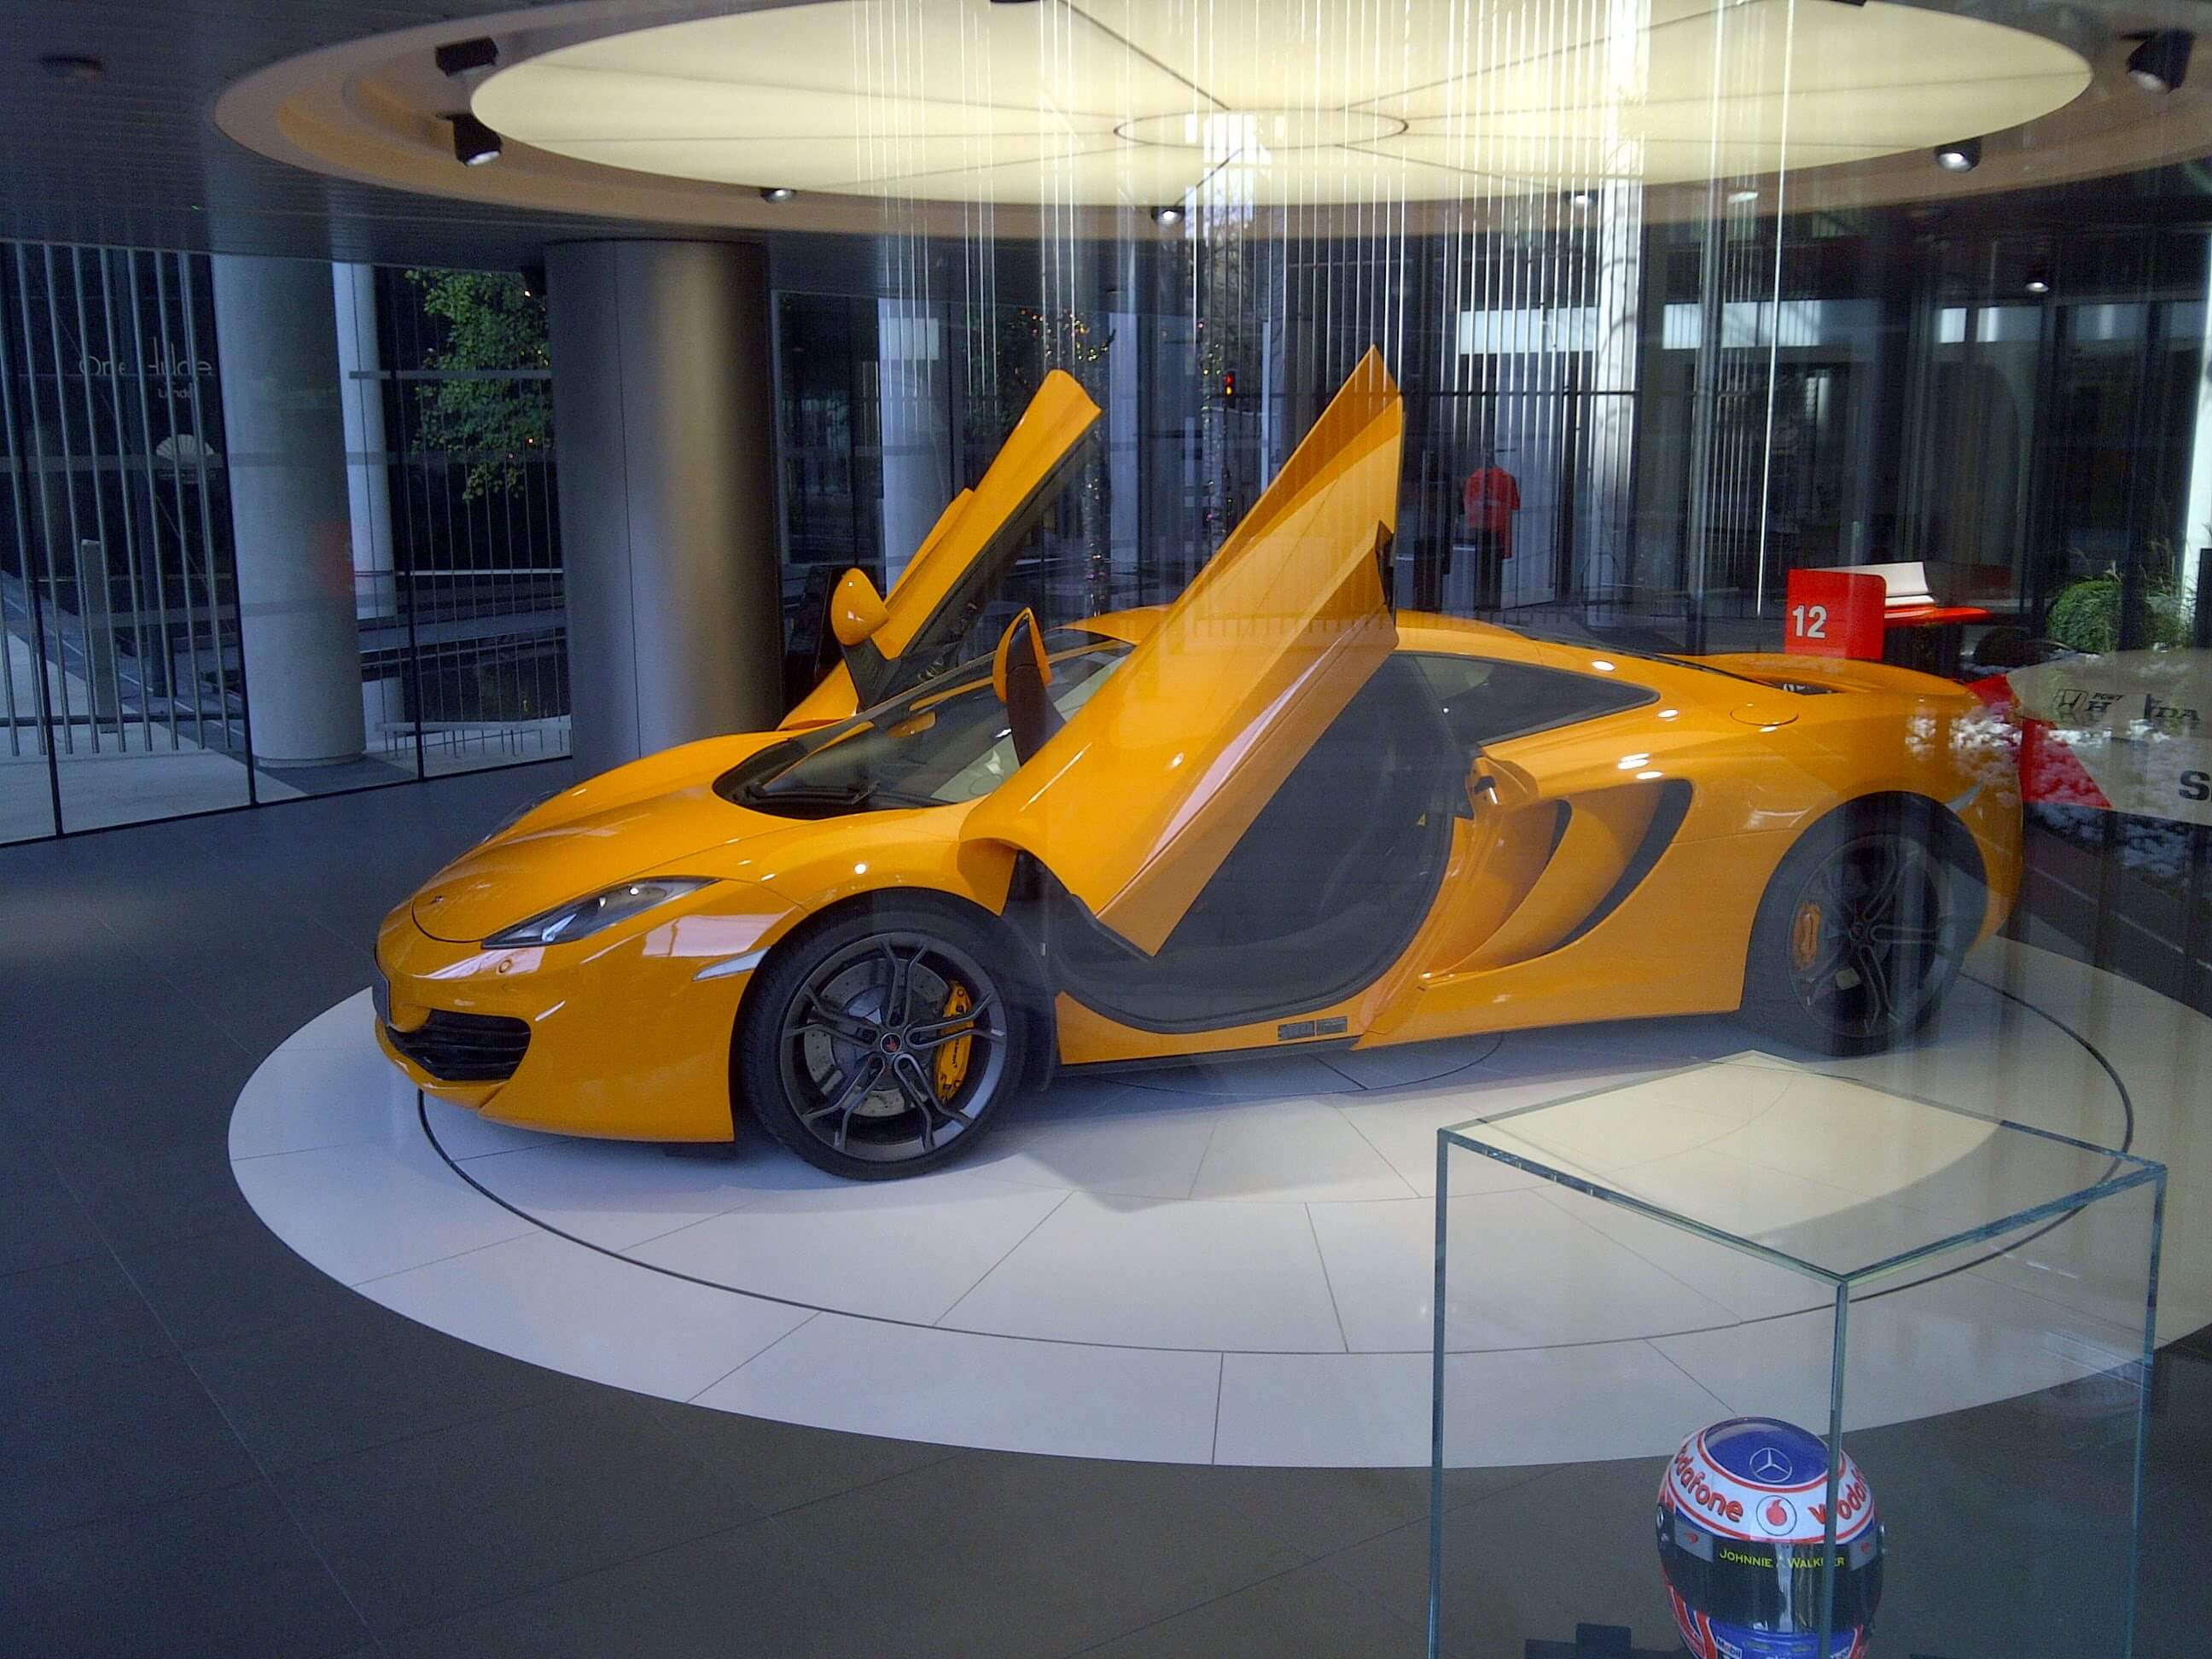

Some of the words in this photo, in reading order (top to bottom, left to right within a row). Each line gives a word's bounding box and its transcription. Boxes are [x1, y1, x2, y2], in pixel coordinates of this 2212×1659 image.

[1792, 605, 1827, 638] 12
[2179, 770, 2212, 802] S
[1720, 1549, 1773, 1569] JOHNNIE
[1716, 1638, 1741, 1657] Mobil
